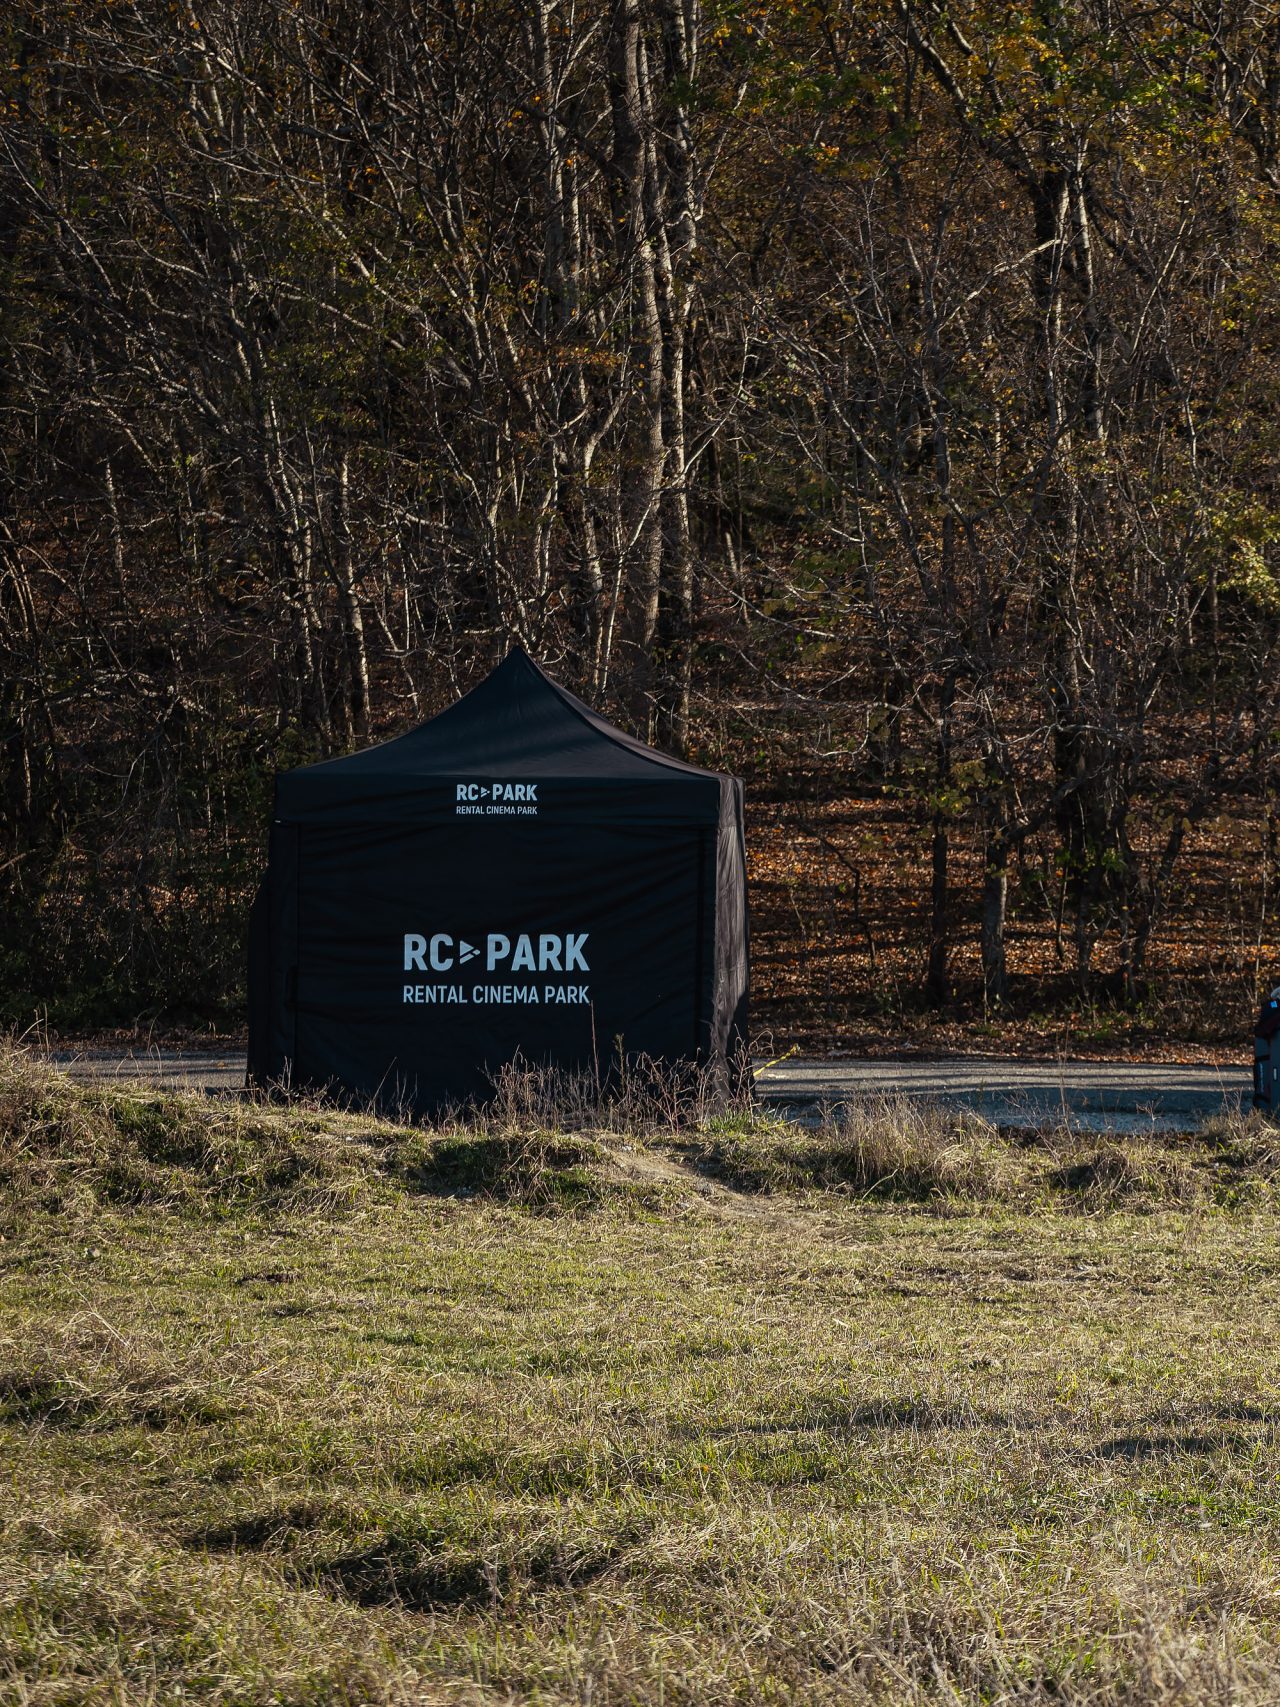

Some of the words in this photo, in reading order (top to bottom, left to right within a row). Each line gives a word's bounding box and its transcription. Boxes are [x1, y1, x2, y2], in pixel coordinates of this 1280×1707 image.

[456, 784, 479, 801] RC
[492, 784, 538, 801] PARK
[456, 805, 485, 815] RENTAL
[486, 805, 516, 815] CINEMA
[517, 806, 538, 815] PARK
[403, 933, 454, 971] RC
[486, 933, 590, 971] PARK
[403, 985, 468, 1003] RENTAL
[472, 985, 540, 1004] CINEMA
[544, 985, 590, 1004] PARK
